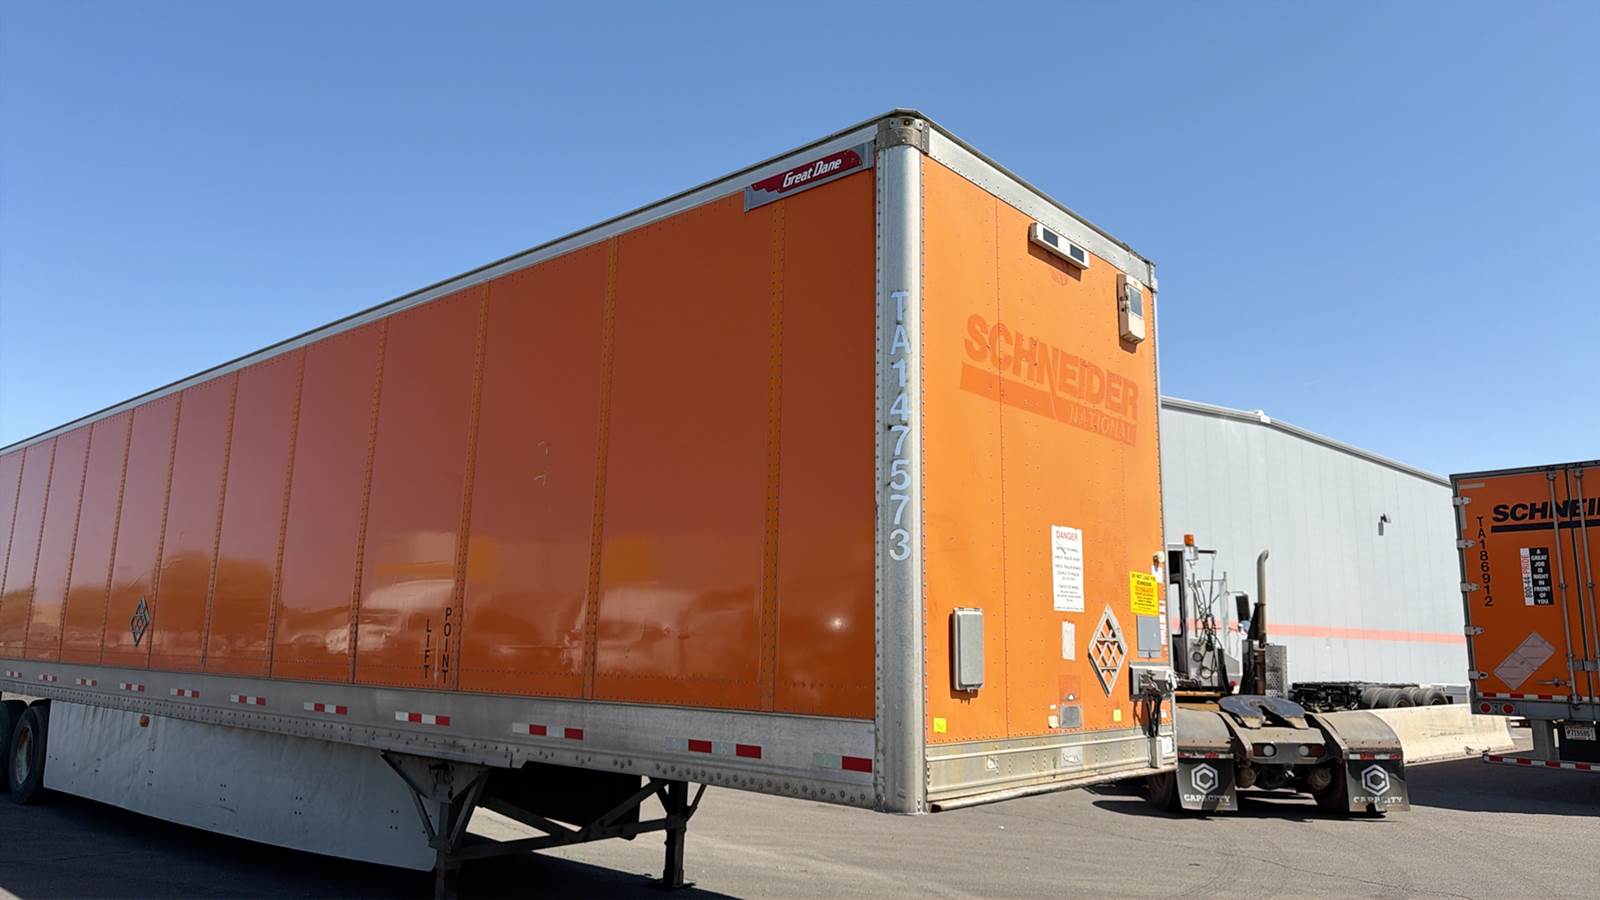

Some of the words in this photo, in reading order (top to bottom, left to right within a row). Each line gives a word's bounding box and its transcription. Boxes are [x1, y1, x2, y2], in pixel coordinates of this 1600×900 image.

[783, 167, 812, 187] Great
[813, 159, 842, 178] Dane
[964, 314, 1139, 420] SCHNEIDER
[1070, 404, 1136, 446] NATIONAL
[1056, 530, 1078, 541] DANGER
[1492, 498, 1600, 522] SCHNEI
[1476, 516, 1493, 607] TA186912
[424, 619, 432, 679] LIFT
[442, 607, 452, 684] POINT
